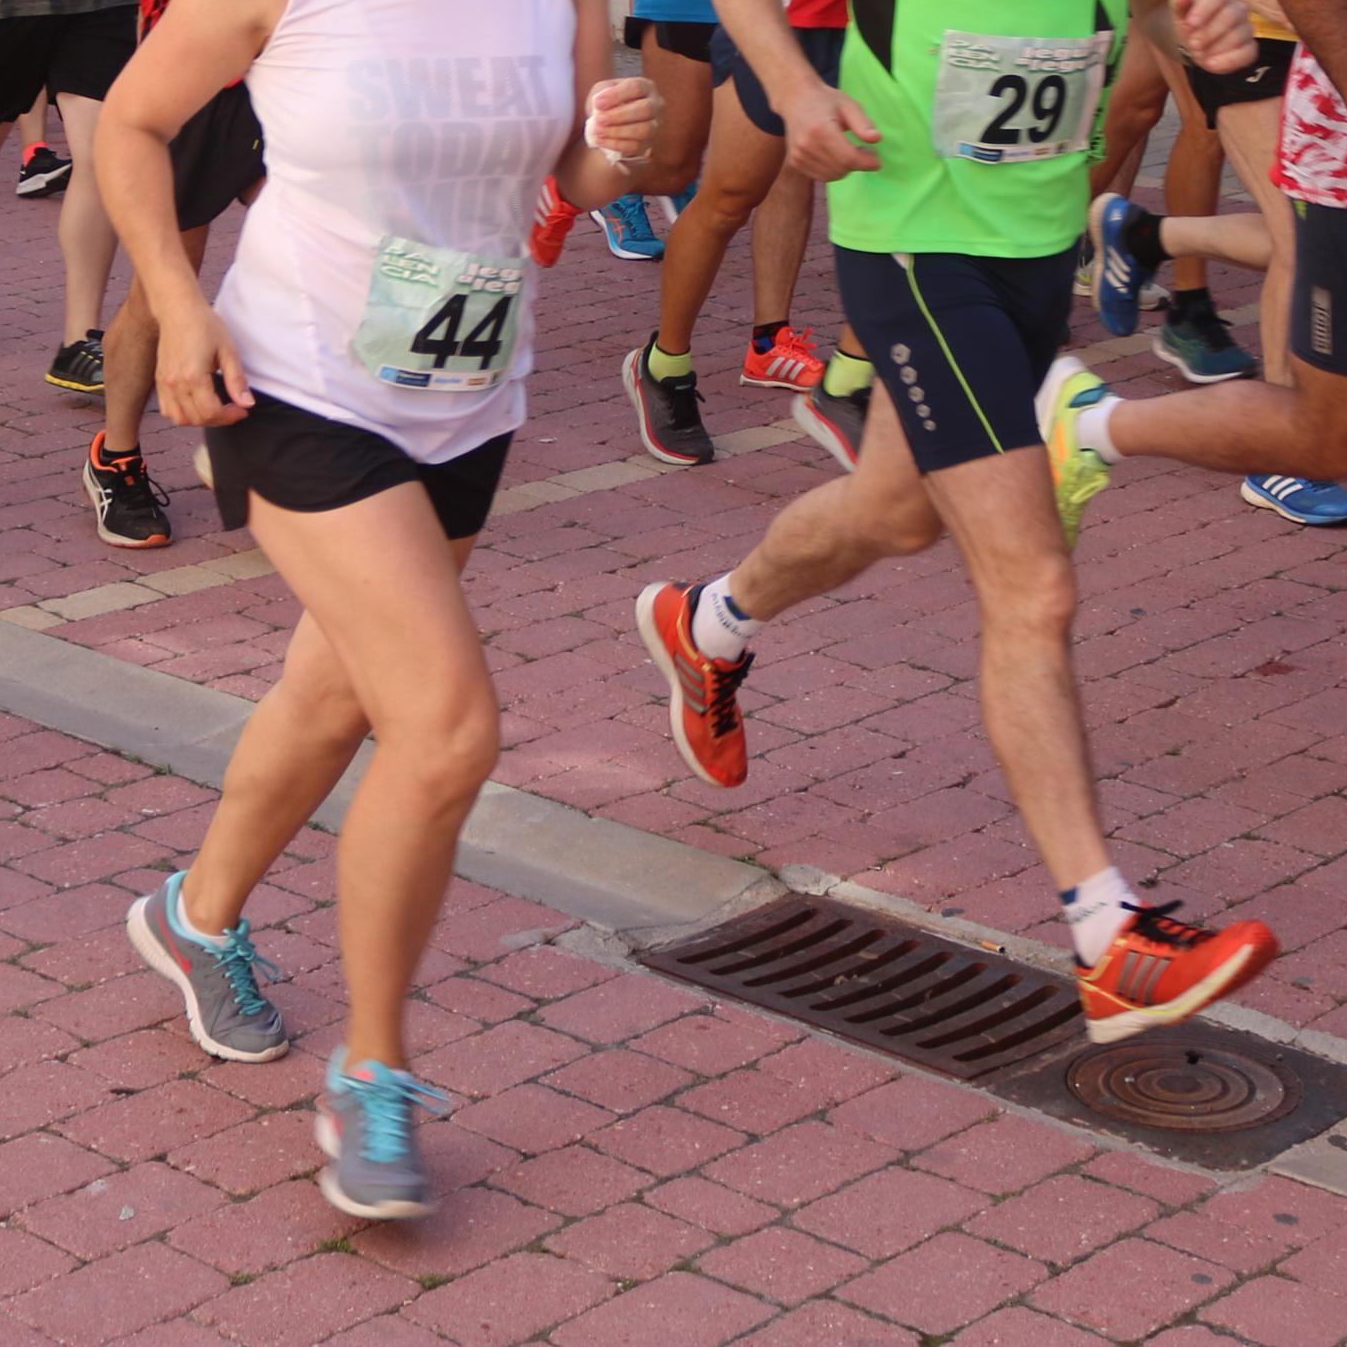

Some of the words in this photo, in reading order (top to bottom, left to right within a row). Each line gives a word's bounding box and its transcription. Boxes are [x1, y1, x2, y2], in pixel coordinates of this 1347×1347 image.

[348, 55, 552, 121] SWEAT
[979, 74, 1066, 145] 29
[410, 294, 519, 371] 44
